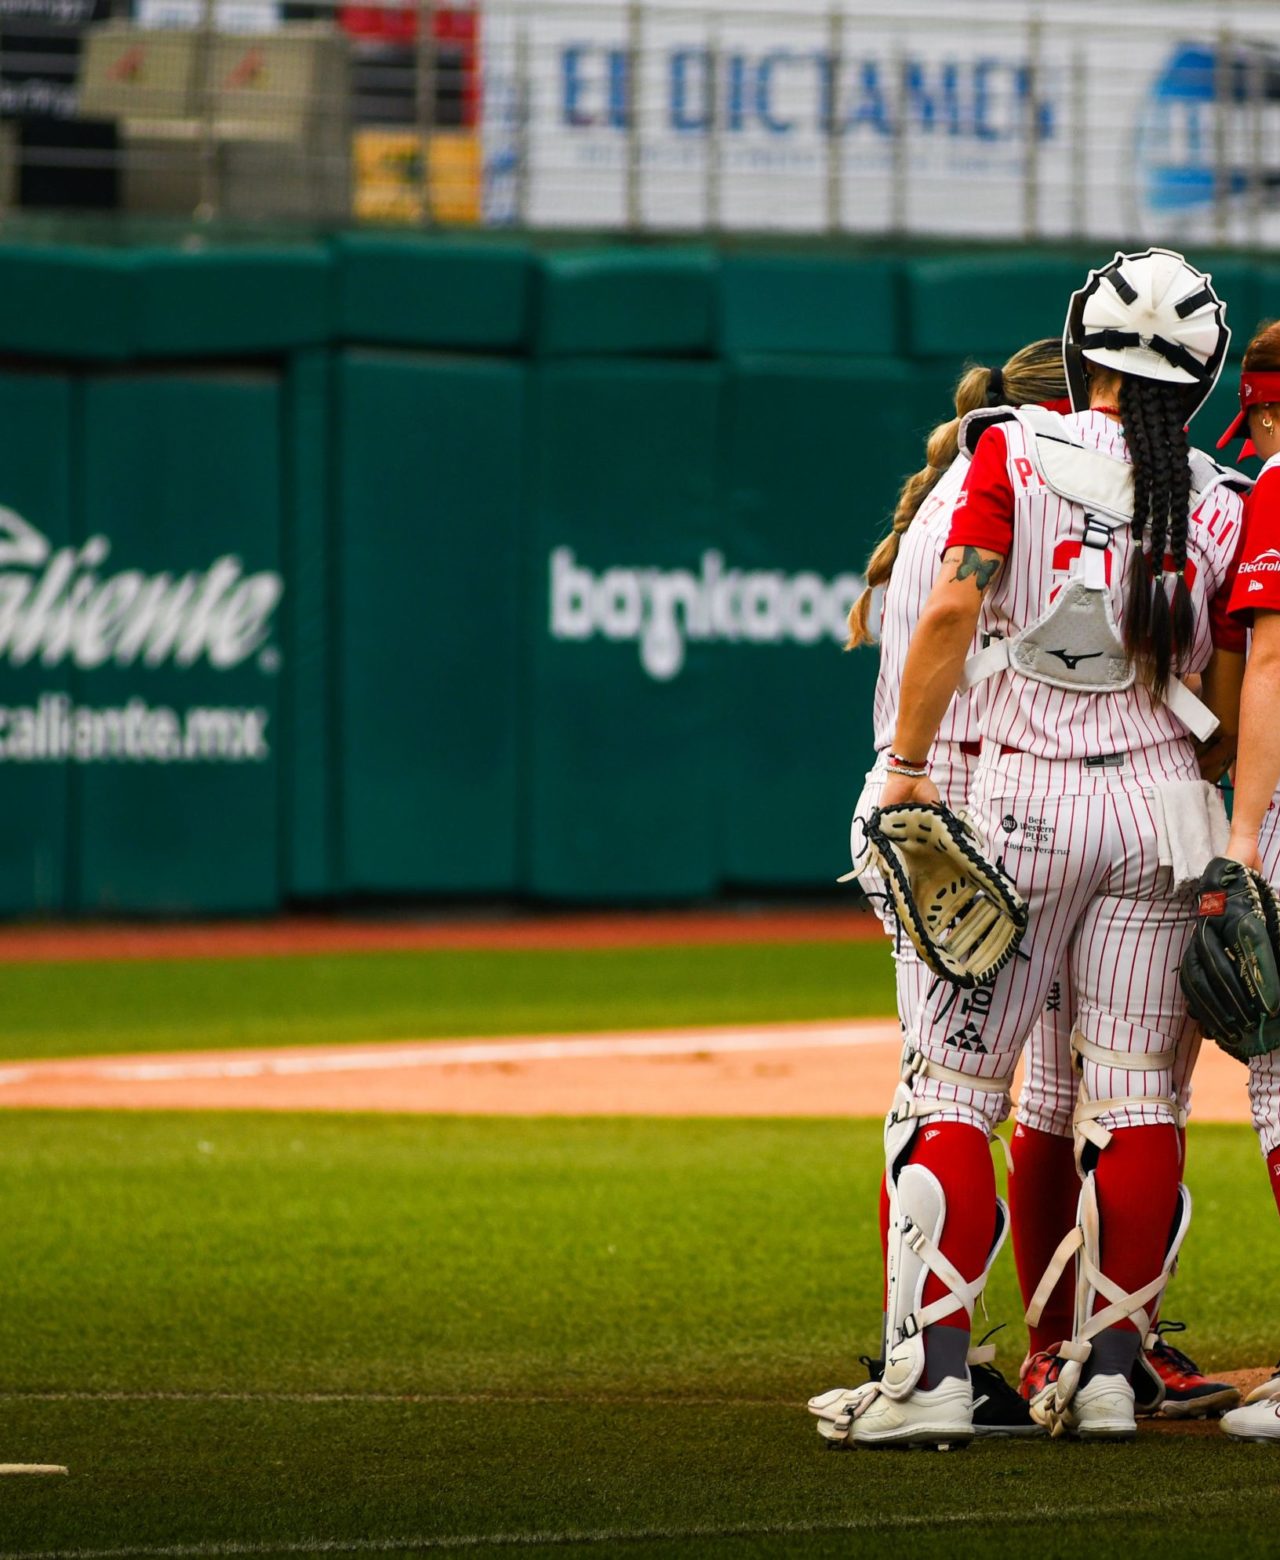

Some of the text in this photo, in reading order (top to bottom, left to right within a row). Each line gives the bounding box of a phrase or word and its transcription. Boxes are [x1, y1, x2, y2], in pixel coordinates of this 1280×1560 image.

[1028, 816, 1047, 825] Best
[1020, 822, 1055, 834] Western
[1025, 832, 1049, 842] PLUS
